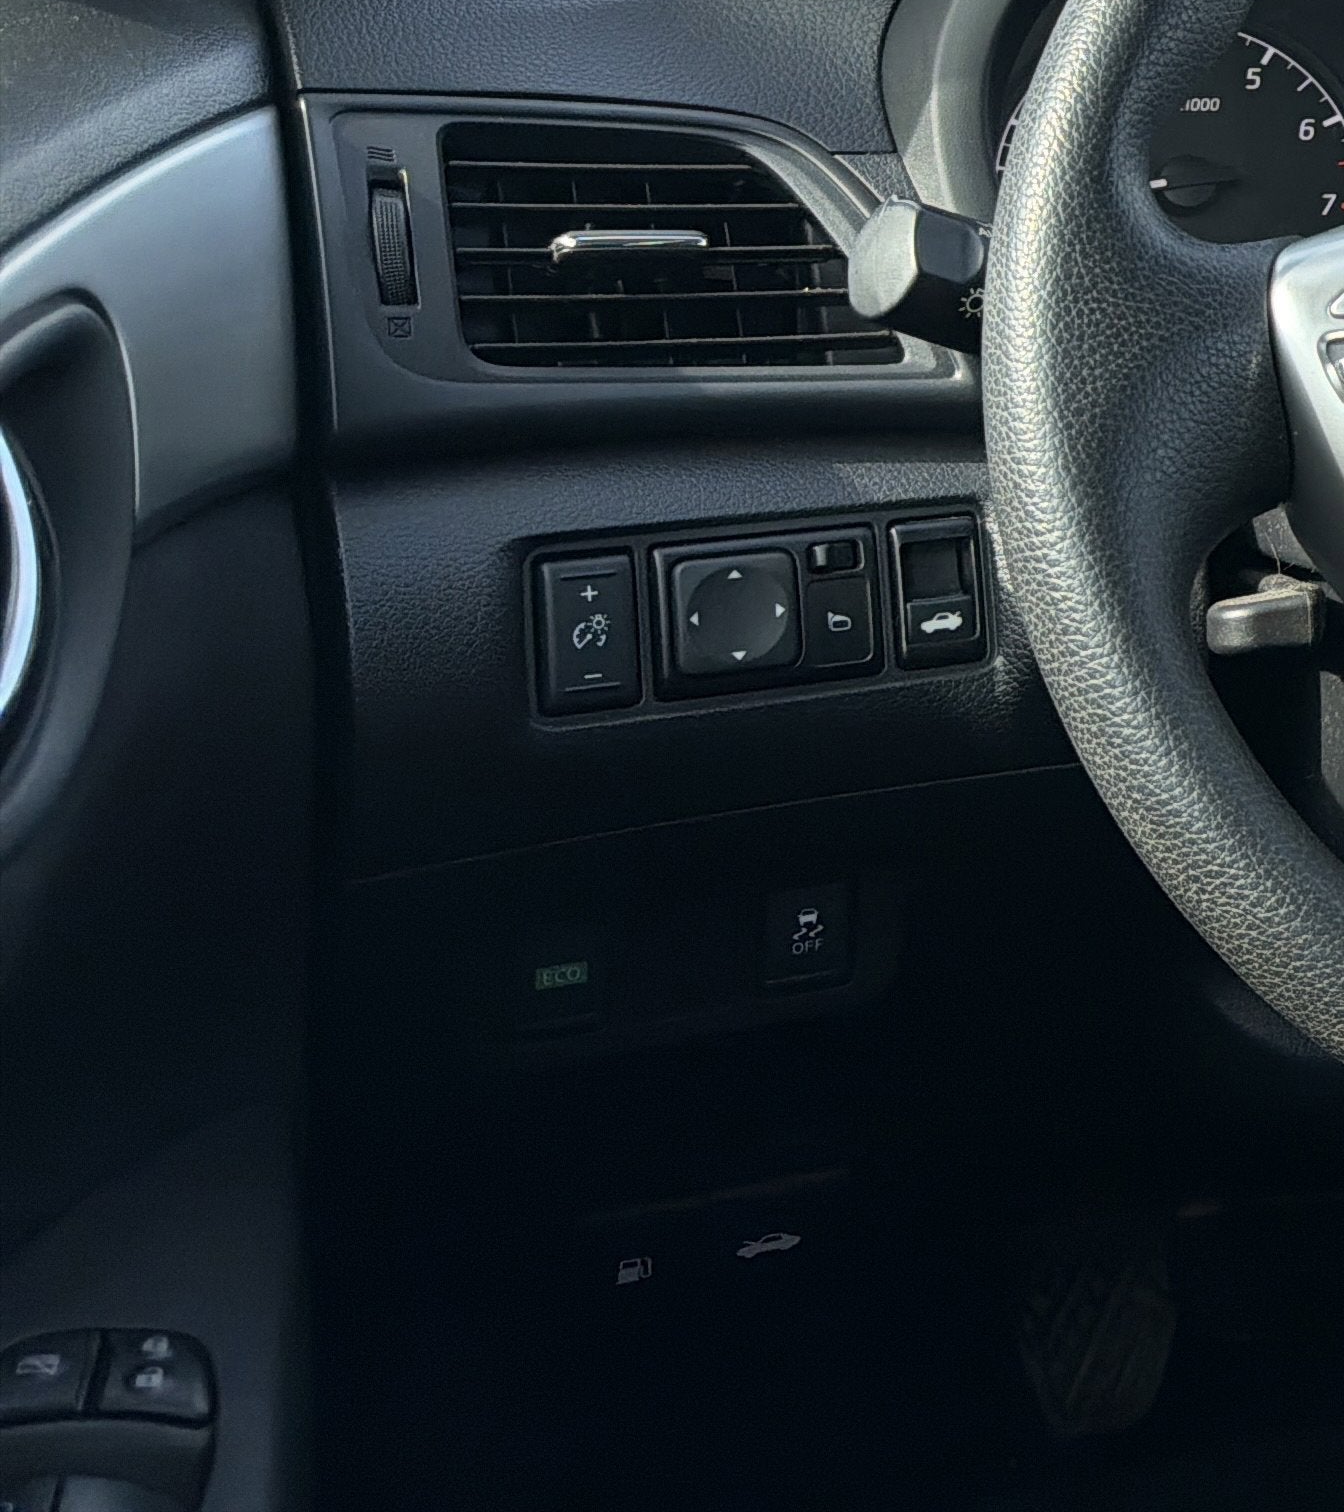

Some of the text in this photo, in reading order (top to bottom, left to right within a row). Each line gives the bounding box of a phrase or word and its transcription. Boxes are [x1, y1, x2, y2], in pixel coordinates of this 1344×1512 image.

[1245, 67, 1262, 89] 5
[1299, 118, 1315, 140] 6
[1321, 193, 1337, 216] 7
[792, 938, 824, 955] OFF
[542, 966, 581, 986] ECO
